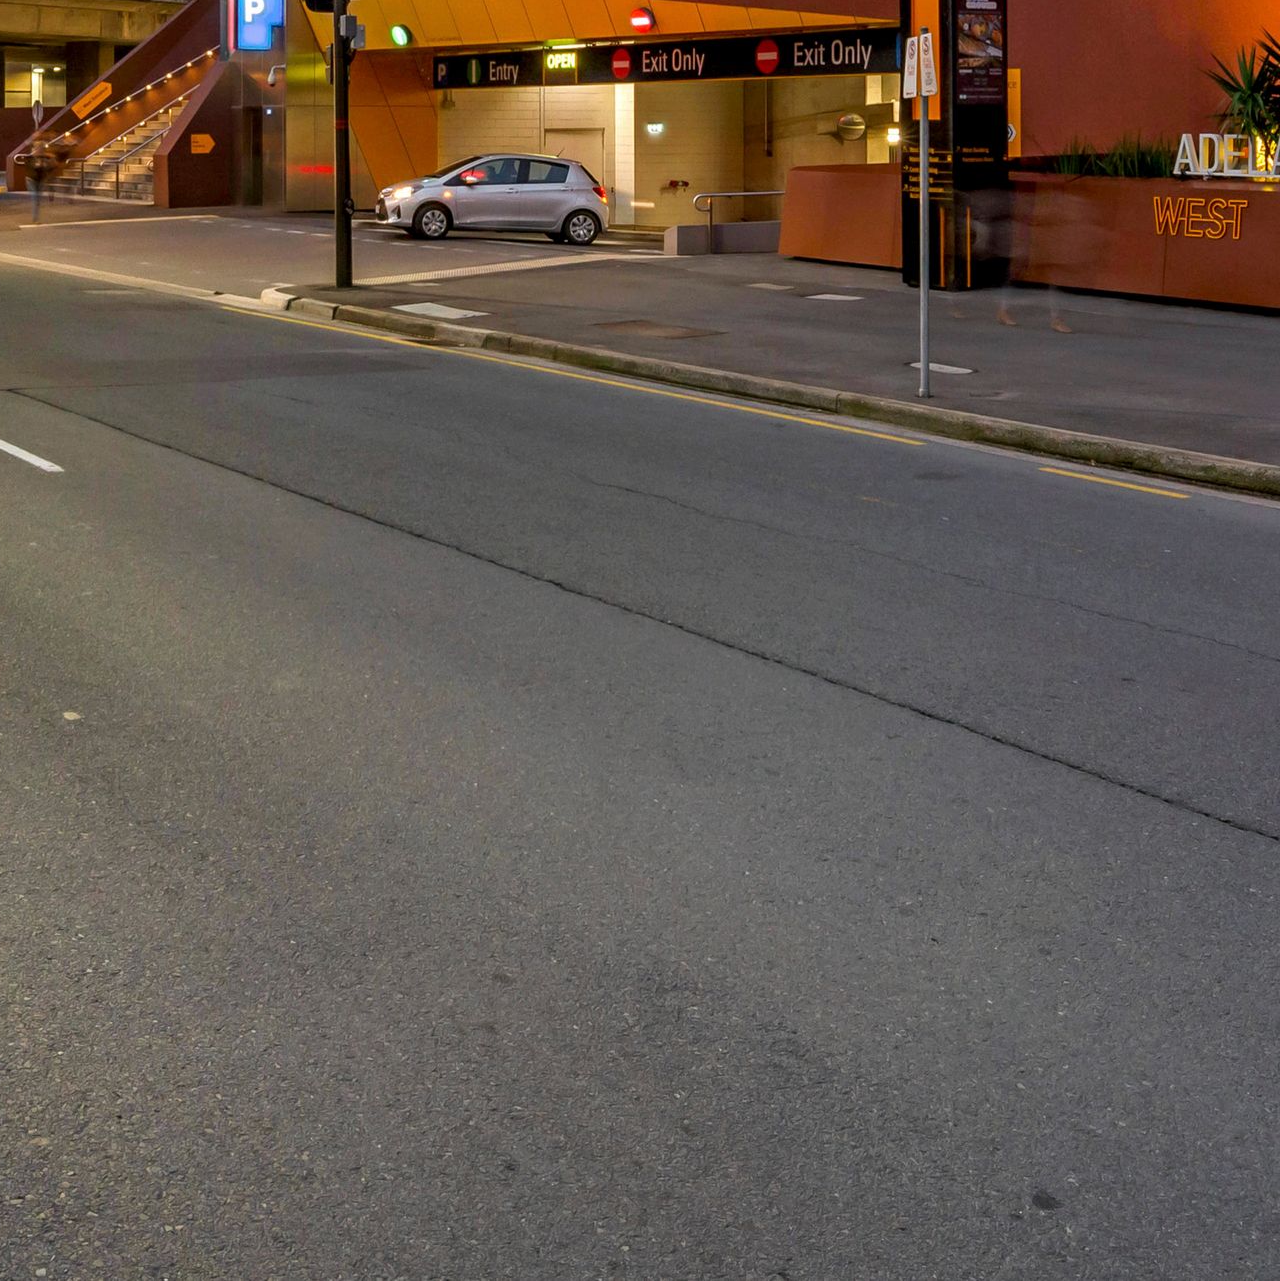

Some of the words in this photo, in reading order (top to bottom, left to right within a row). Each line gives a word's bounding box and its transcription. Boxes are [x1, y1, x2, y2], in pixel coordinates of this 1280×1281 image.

[546, 52, 576, 70] OPEN
[642, 50, 669, 73] Exit
[671, 49, 705, 76] Only
[793, 42, 825, 67] Exit
[828, 39, 873, 70] Only
[438, 63, 447, 82] P
[489, 60, 519, 85] Entry
[1153, 196, 1249, 240] WEST
